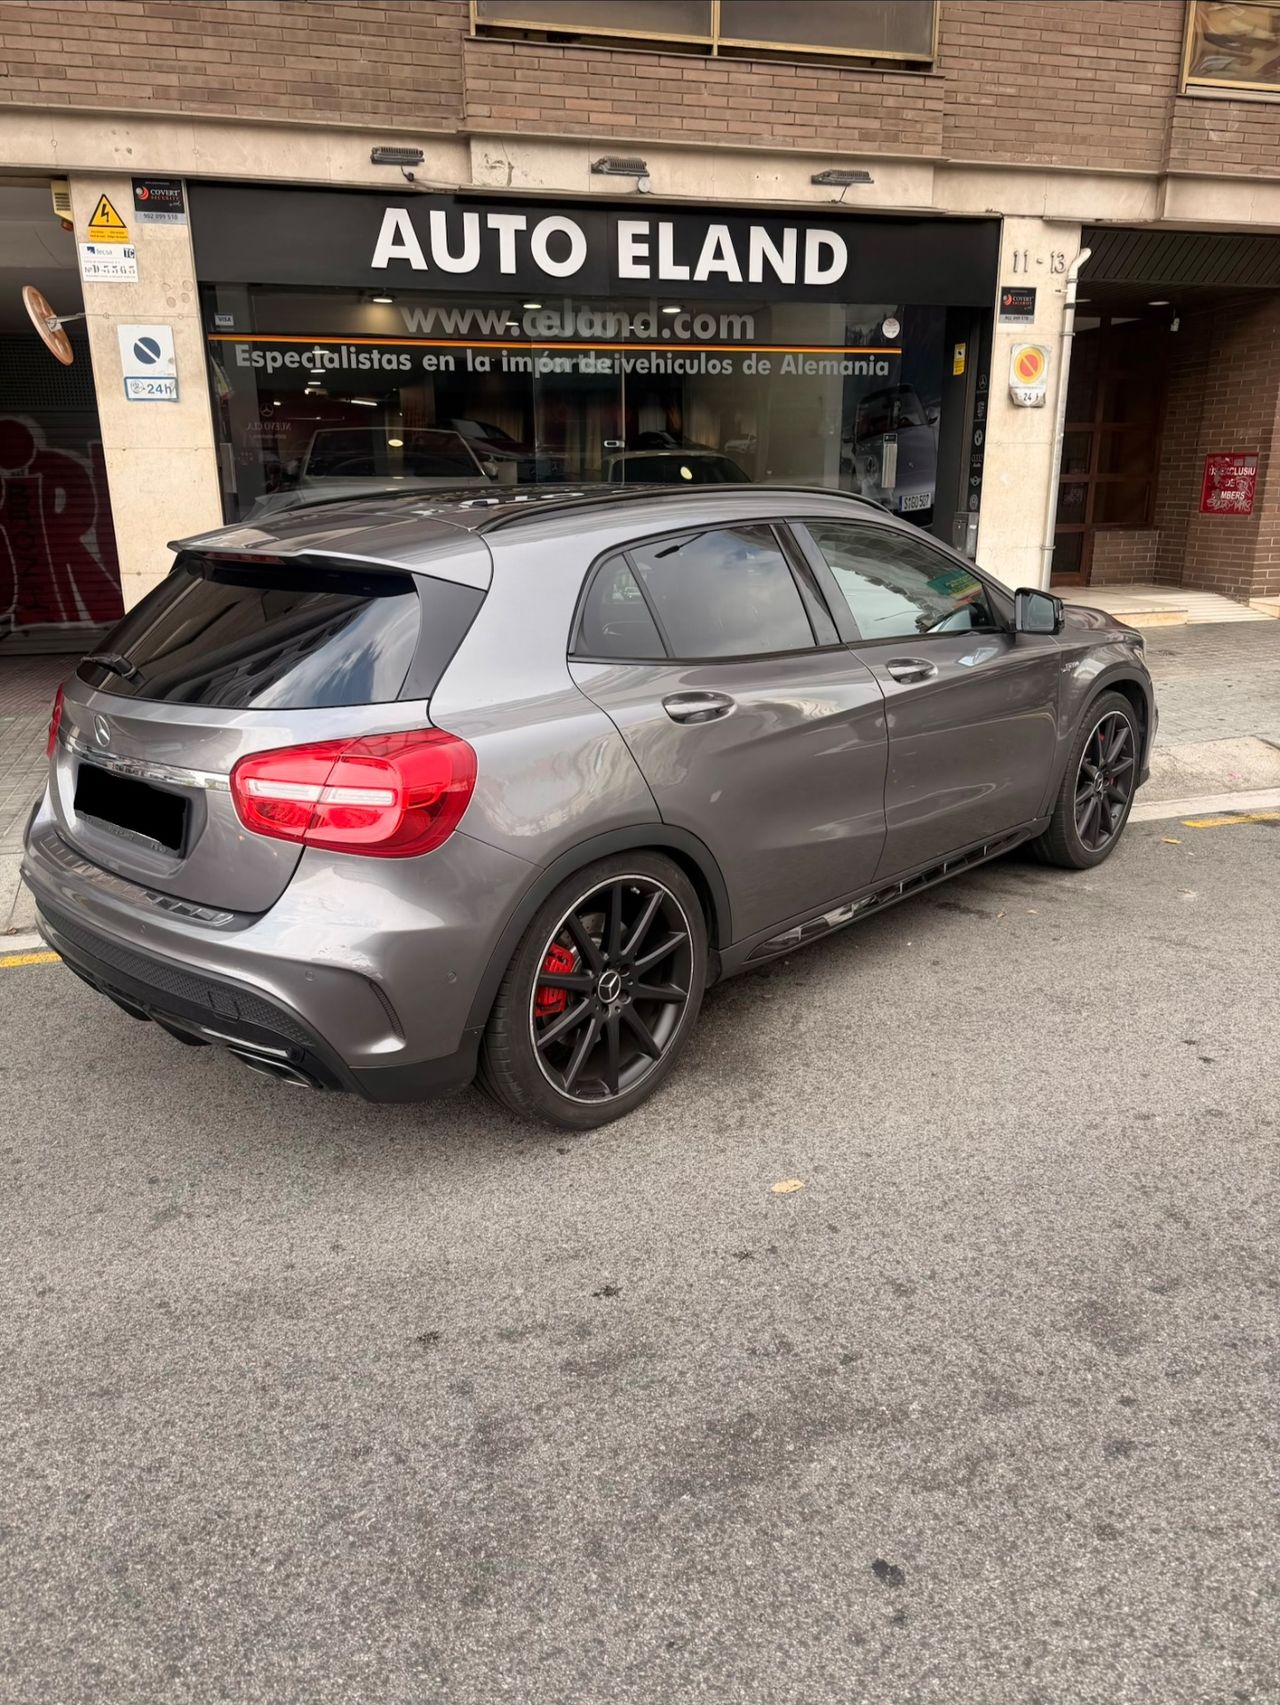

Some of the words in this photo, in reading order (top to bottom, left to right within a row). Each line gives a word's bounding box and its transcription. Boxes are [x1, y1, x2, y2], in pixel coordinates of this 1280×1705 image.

[151, 189, 177, 197] COVERT
[371, 207, 588, 278] AUTO
[617, 219, 848, 285] ELAND
[1013, 249, 1029, 273] 11
[1050, 250, 1067, 274] 13
[235, 344, 412, 374] Especialistas
[422, 352, 455, 372] en
[466, 349, 492, 373] la
[622, 351, 733, 375] vehiculos
[742, 352, 772, 376] de
[780, 354, 889, 378] Alemania
